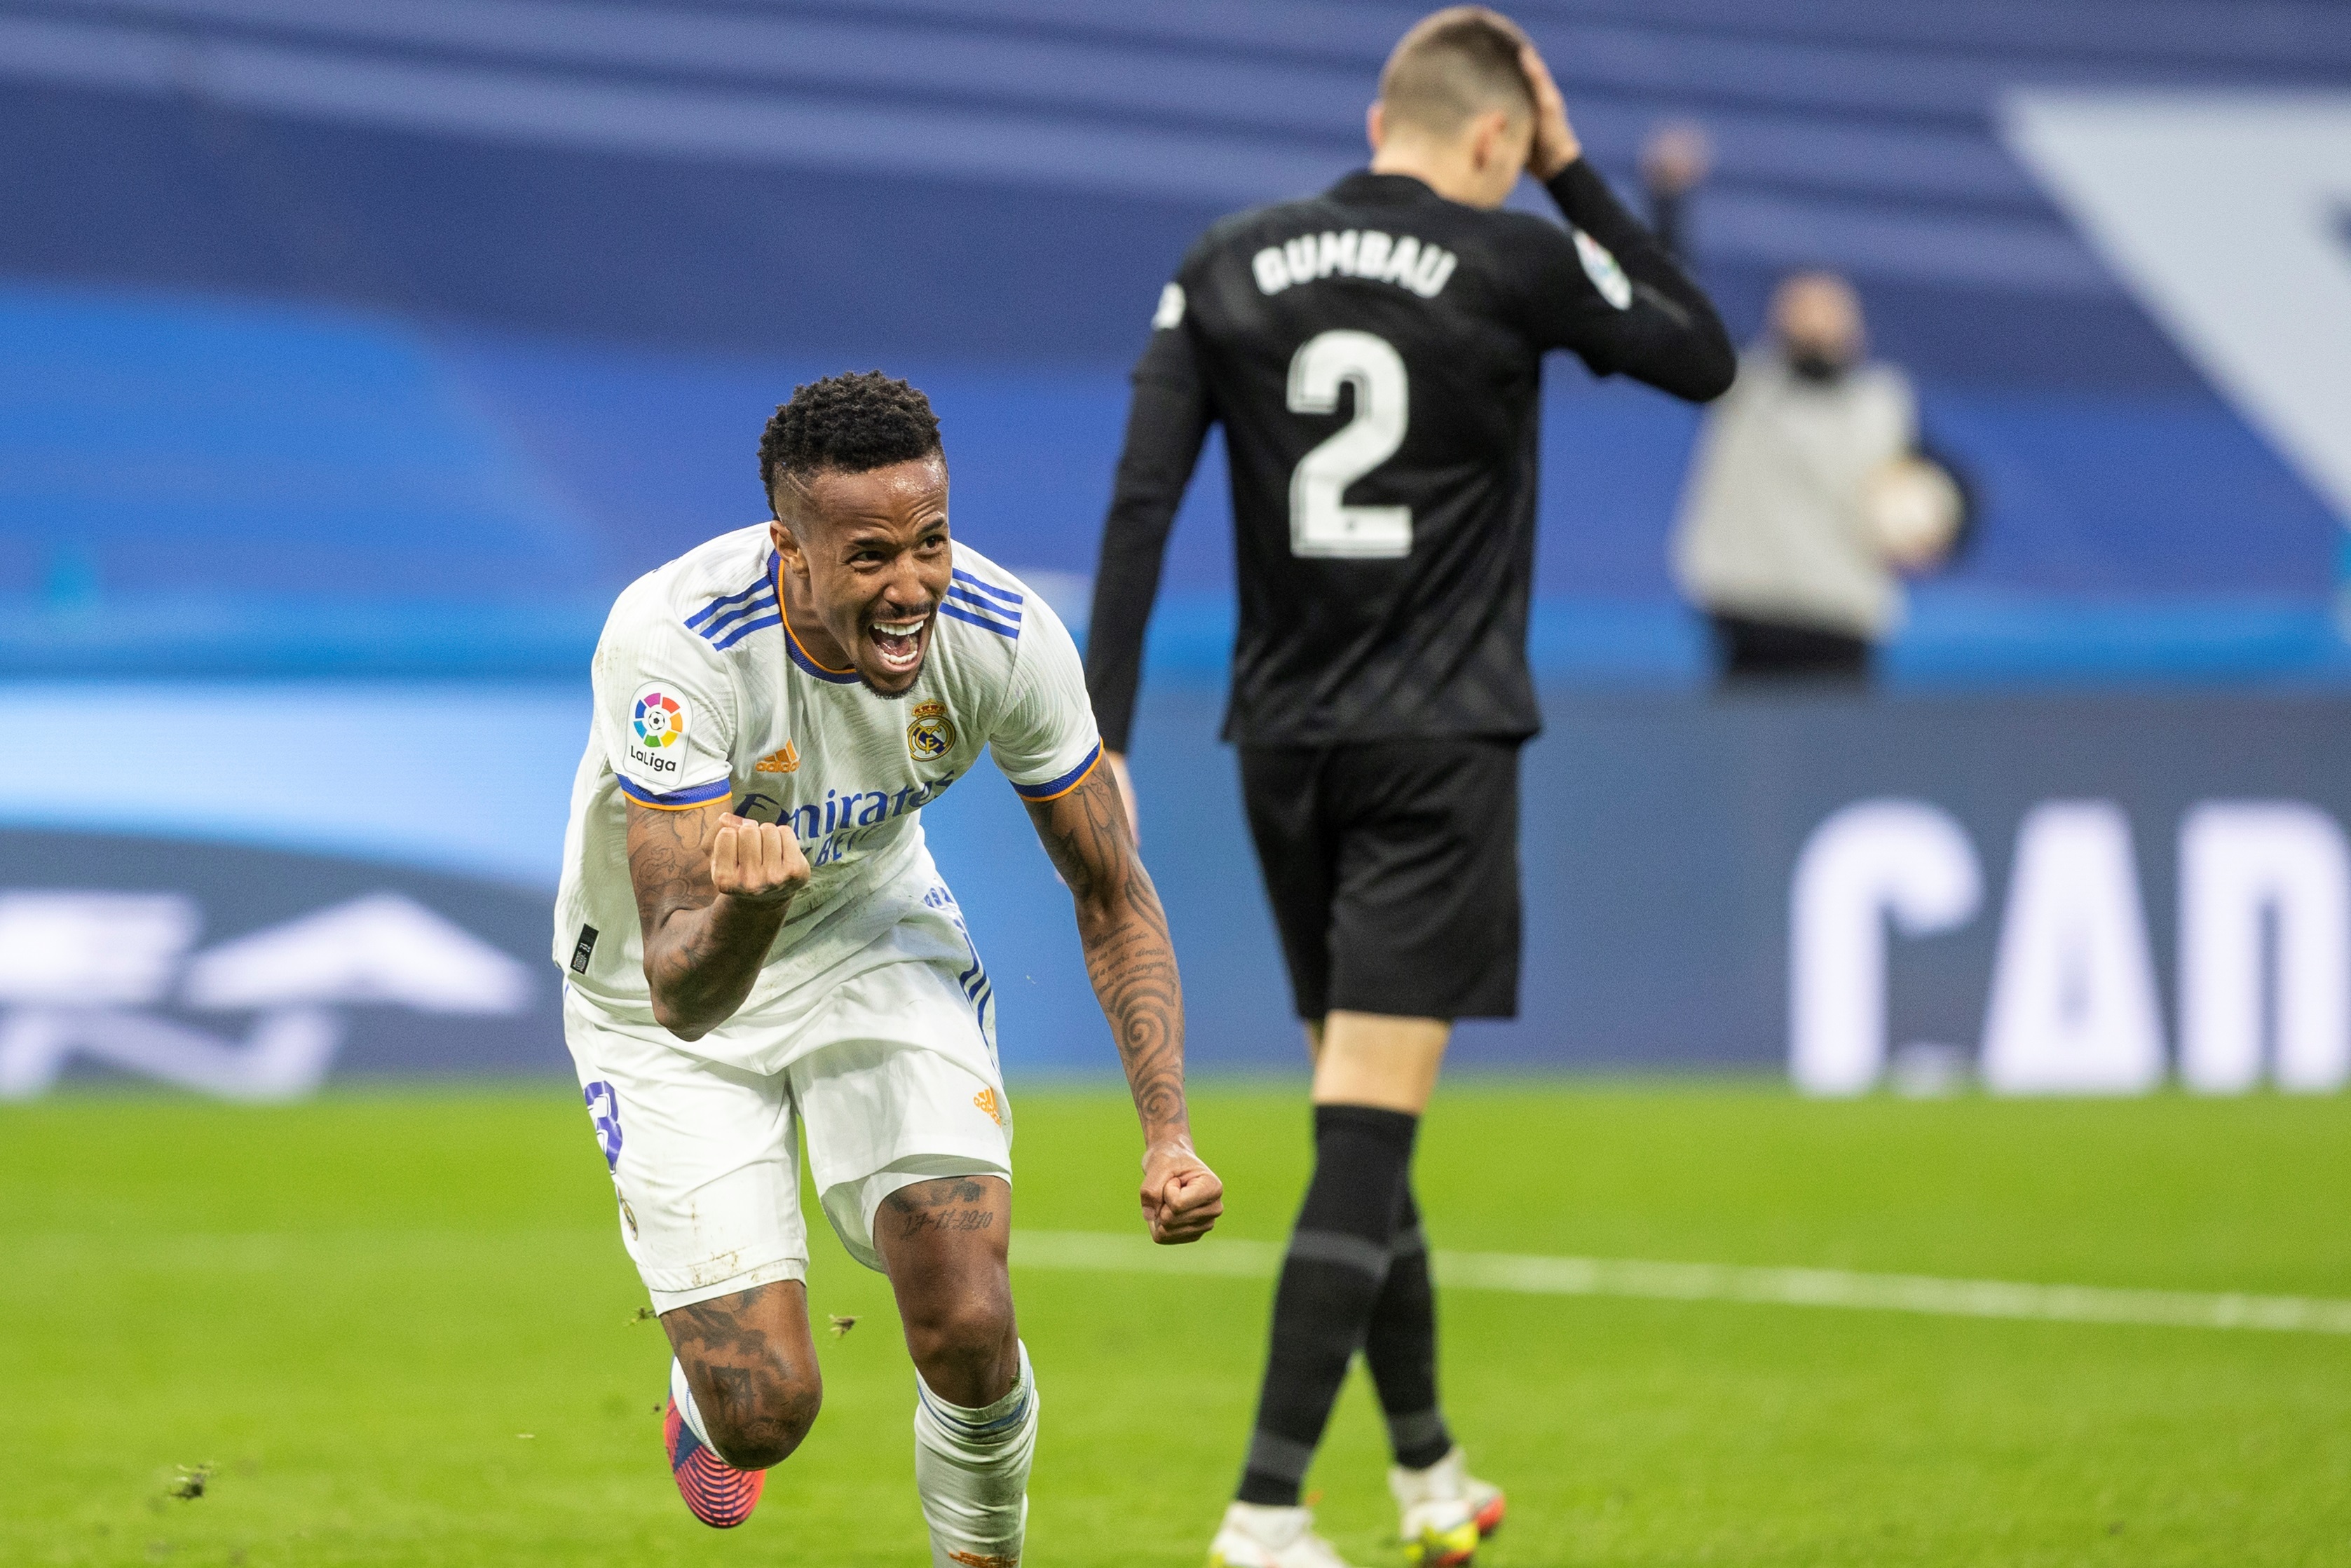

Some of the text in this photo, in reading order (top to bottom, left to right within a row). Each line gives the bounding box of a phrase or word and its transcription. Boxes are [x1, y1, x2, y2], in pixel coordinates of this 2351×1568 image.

[1286, 329, 1413, 559] 2
[630, 745, 676, 772] LaLiga
[755, 760, 800, 773] adida
